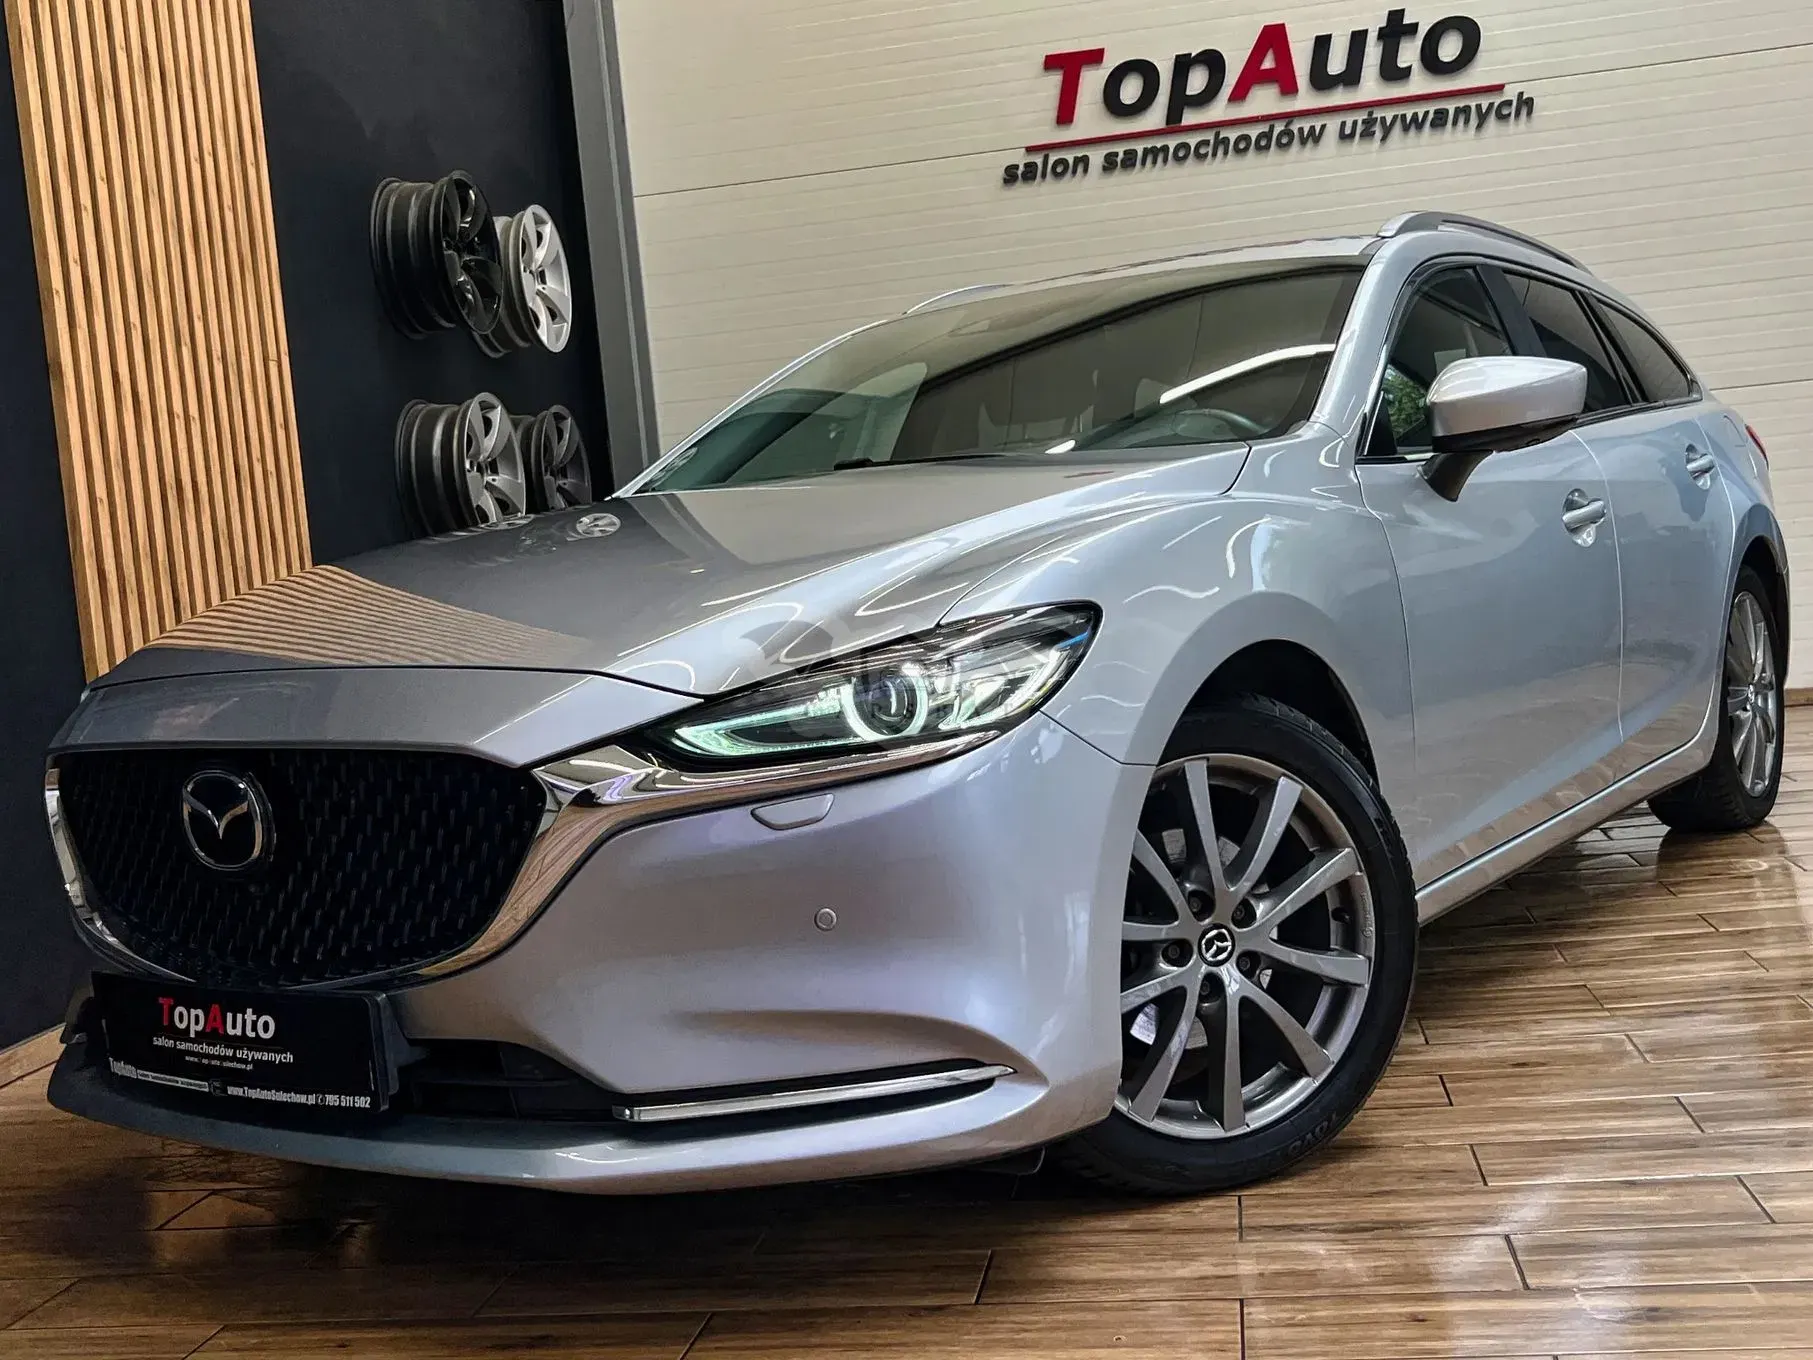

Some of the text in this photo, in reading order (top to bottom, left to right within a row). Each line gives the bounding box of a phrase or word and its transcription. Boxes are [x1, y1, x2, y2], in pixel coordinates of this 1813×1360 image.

[1043, 8, 1481, 126] TopAuto
[1003, 91, 1535, 185] salon samochodów używanych
[158, 997, 276, 1039] TopAuto
[153, 1036, 294, 1064] salon samochodów używanych
[325, 1094, 340, 1106] 795
[341, 1096, 354, 1107] 511
[355, 1096, 371, 1108] 502
